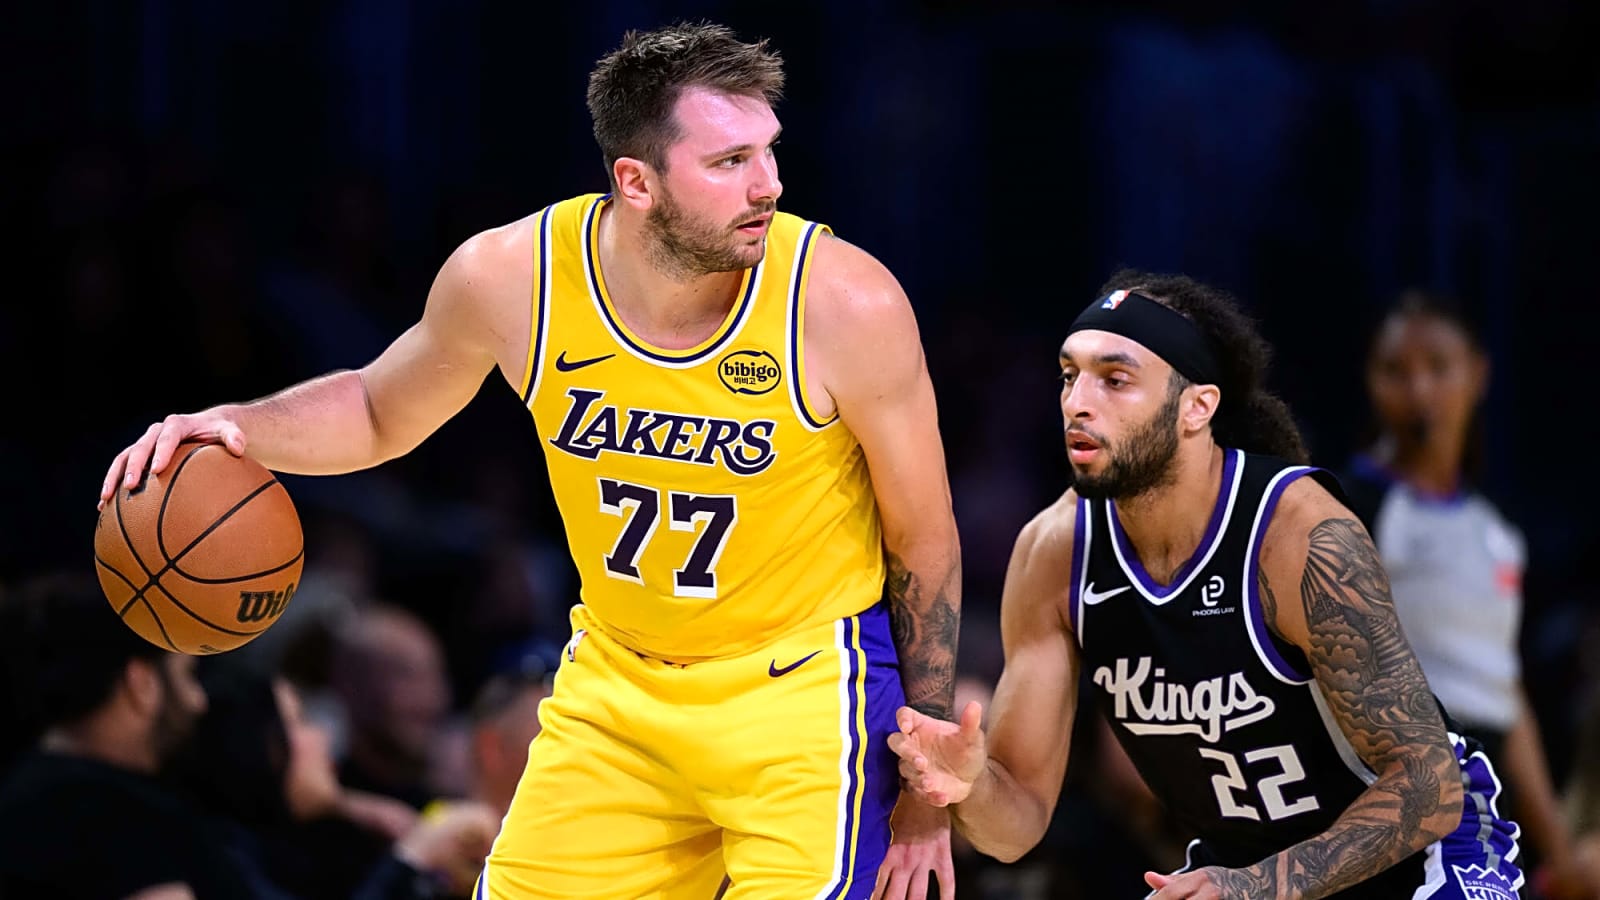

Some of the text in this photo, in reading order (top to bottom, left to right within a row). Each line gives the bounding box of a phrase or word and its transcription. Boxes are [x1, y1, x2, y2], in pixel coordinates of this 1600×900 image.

[724, 361, 777, 382] bibigo
[733, 377, 757, 385] 비비고
[549, 387, 777, 476] LAKERS
[597, 477, 738, 599] 77
[1192, 606, 1235, 617] PHOONG LAW
[1093, 656, 1276, 743] Kings
[1198, 743, 1320, 822] 22
